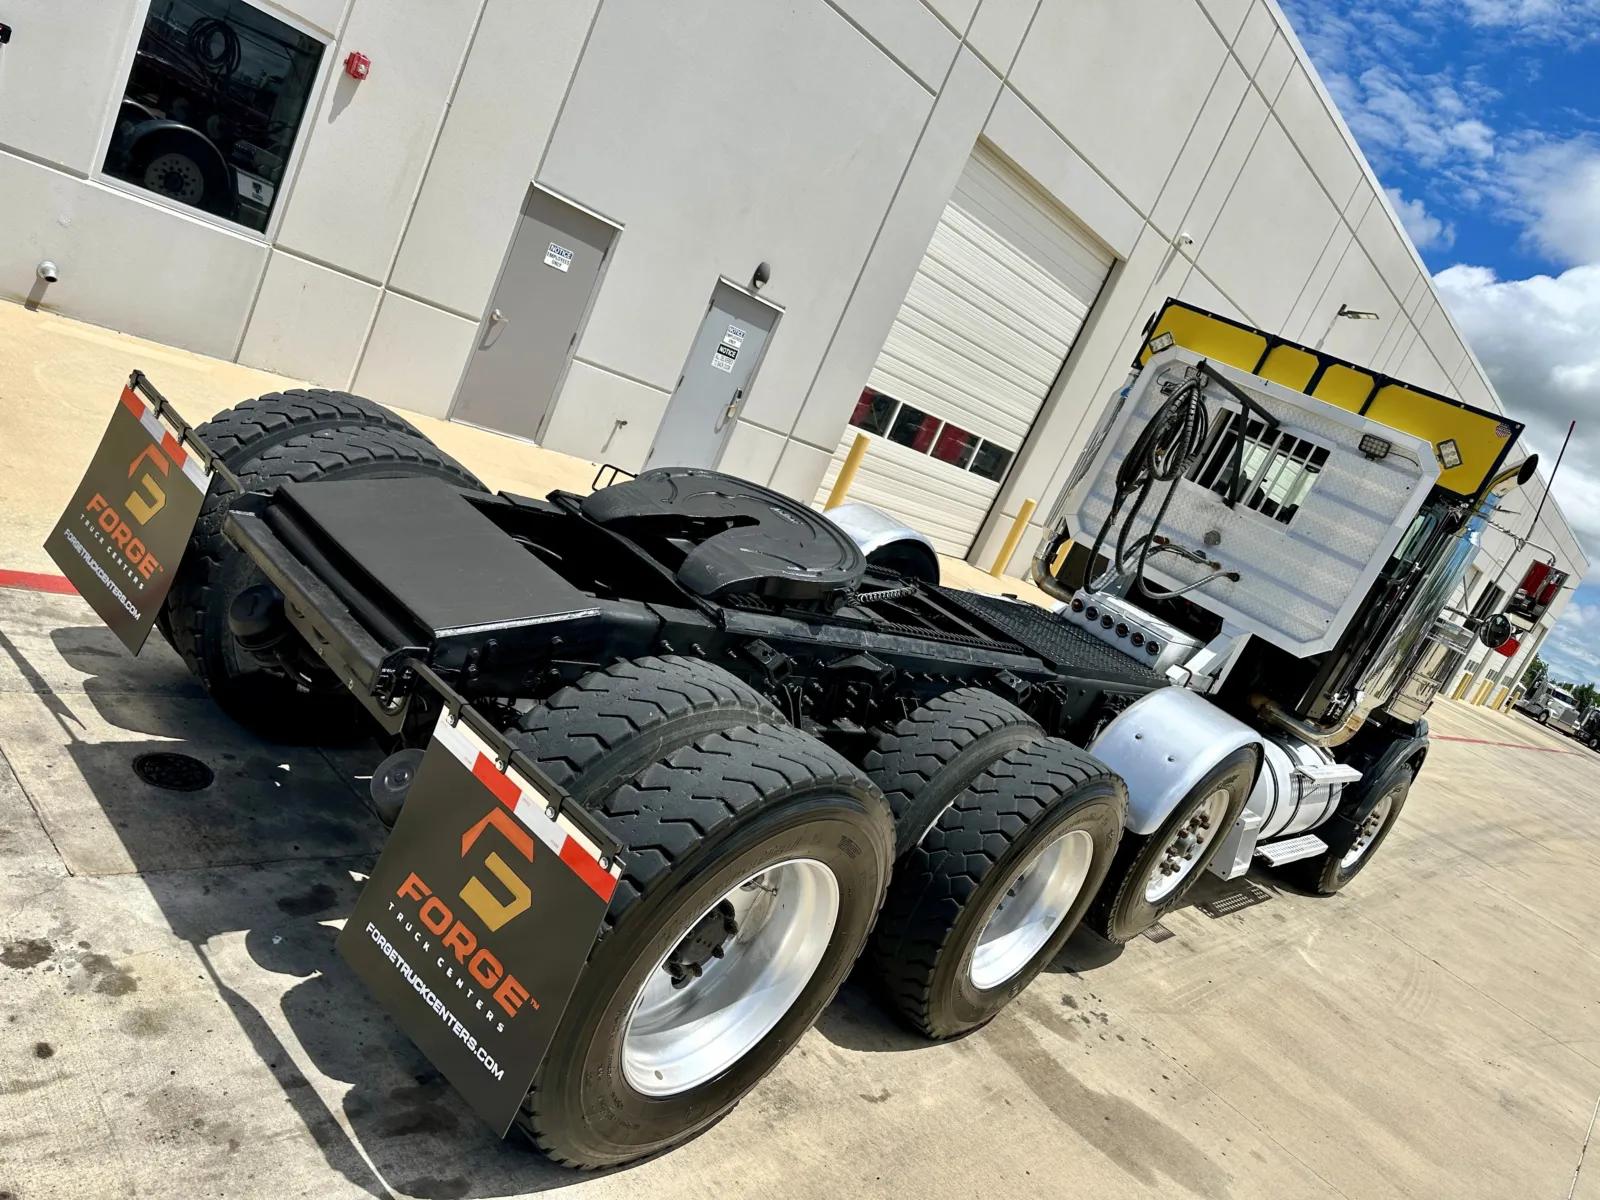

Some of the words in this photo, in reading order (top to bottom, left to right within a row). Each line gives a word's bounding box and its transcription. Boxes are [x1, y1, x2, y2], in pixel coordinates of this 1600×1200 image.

[550, 243, 573, 259] NOTICE
[719, 345, 738, 359] NOTICE
[63, 528, 142, 621] FORGETRUCKCENTERS.COM
[79, 513, 104, 545] TRUCK
[106, 545, 144, 591] CENTERS
[85, 492, 160, 580] FORGE
[365, 921, 505, 1081] FORGETRUCKCENTERS.COM
[388, 901, 431, 952] TRUCK
[437, 956, 505, 1034] CENTERS
